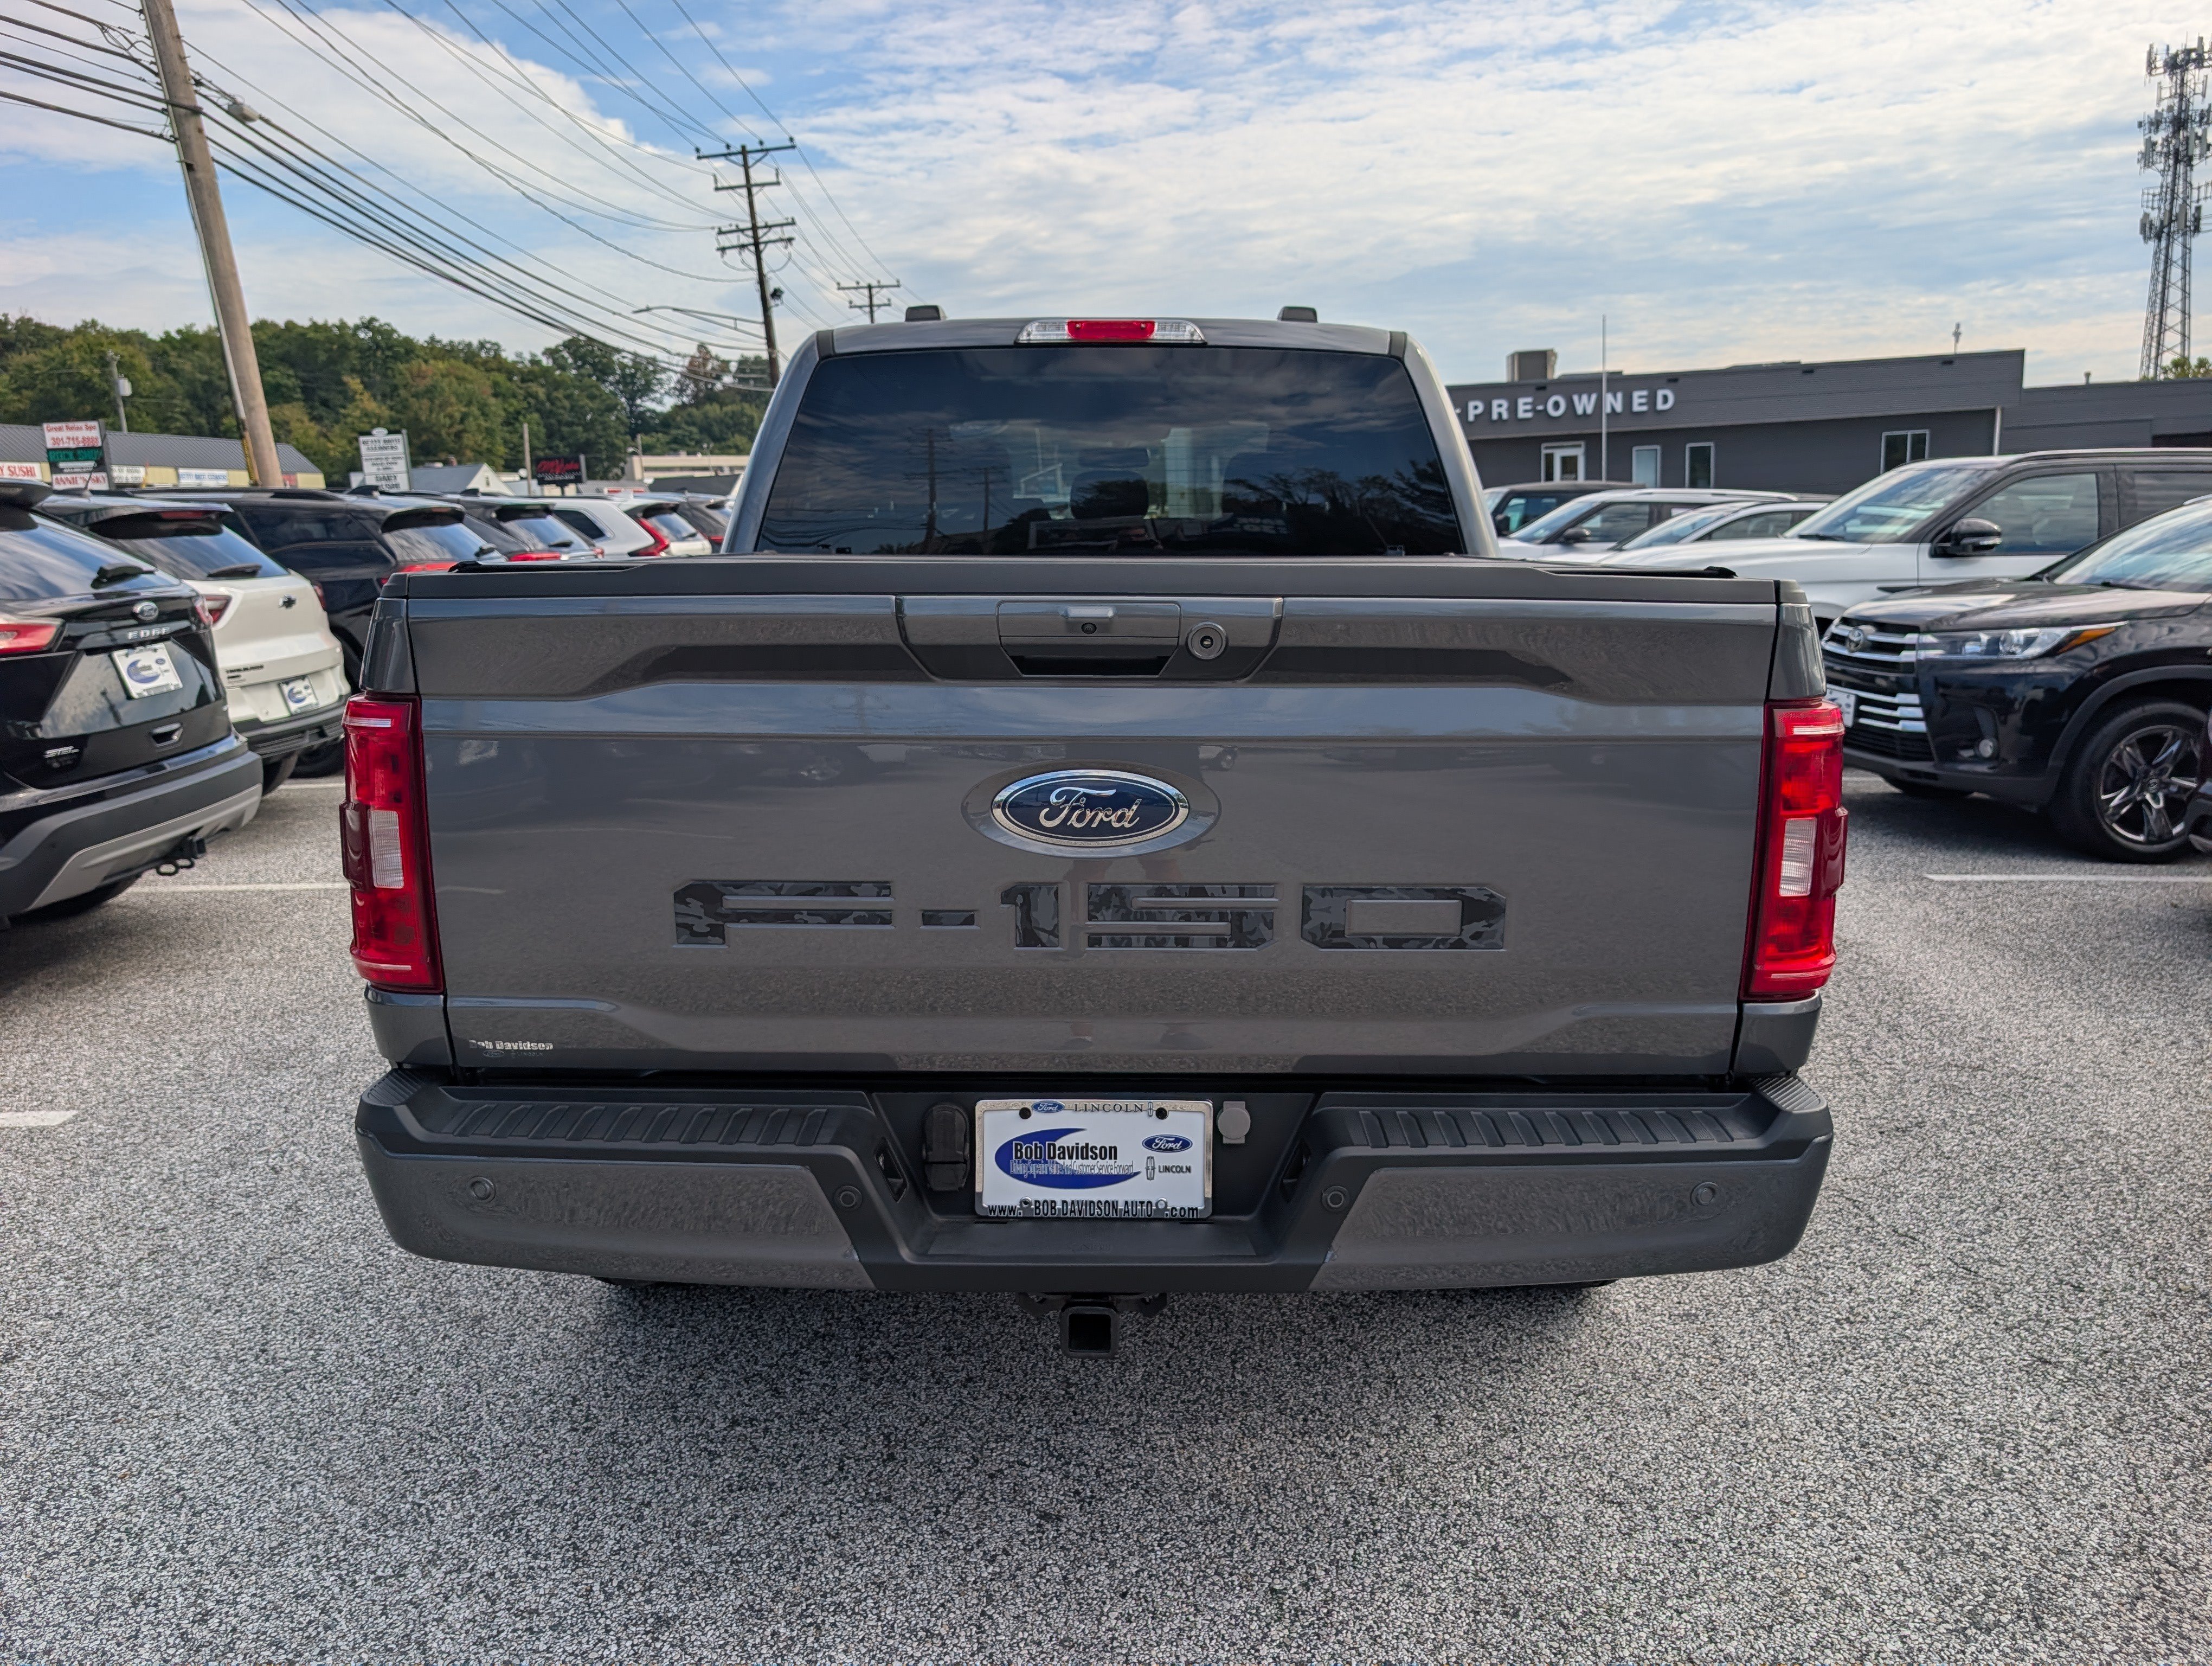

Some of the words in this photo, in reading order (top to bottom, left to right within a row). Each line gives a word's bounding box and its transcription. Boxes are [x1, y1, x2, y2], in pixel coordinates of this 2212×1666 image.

[1467, 388, 1675, 422] PRE-OWNED
[8, 465, 36, 477] SUSHI
[127, 626, 170, 640] EDGE
[1039, 786, 1142, 828] Ford
[673, 878, 1508, 952] F-150
[469, 1040, 493, 1050] Bob
[494, 1040, 554, 1051] Davidson
[1037, 1101, 1058, 1112] Ford
[1073, 1103, 1143, 1113] LINCOLN
[1013, 1142, 1043, 1161] Bob
[1047, 1142, 1118, 1161] Davidson
[1152, 1137, 1182, 1150] Ford
[1010, 1160, 1028, 1178] Driving
[1028, 1160, 1048, 1178] Superior
[1073, 1161, 1097, 1175] Customer
[1096, 1161, 1114, 1175] Service
[1113, 1161, 1134, 1175] Forward
[1158, 1165, 1192, 1174] LINCOLN
[1034, 1200, 1060, 1216] BOB
[1062, 1200, 1119, 1217] DAVIDSON
[1123, 1201, 1153, 1218] AUTO
